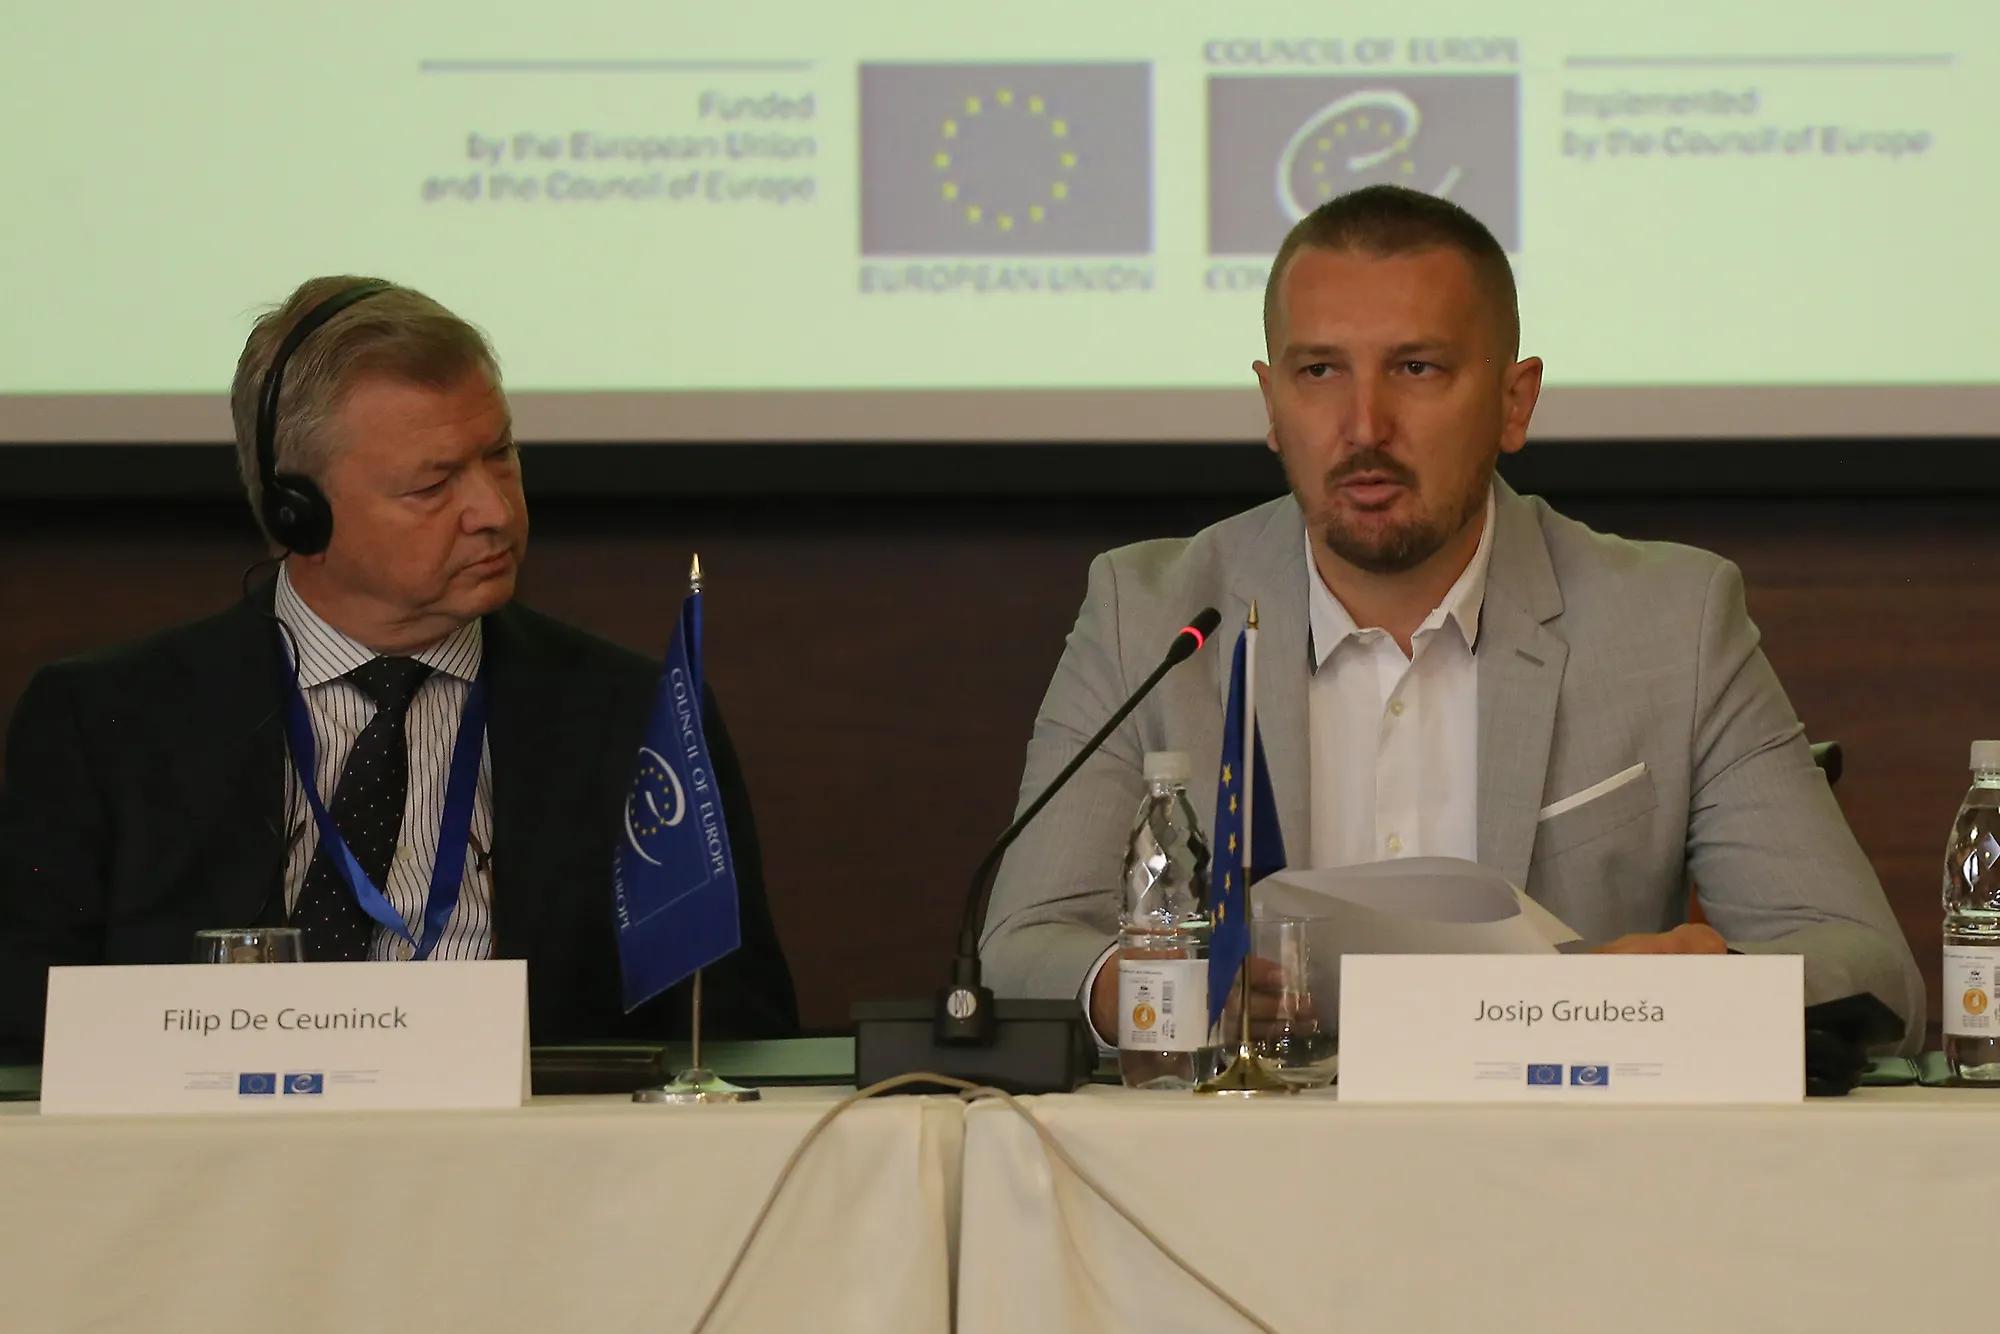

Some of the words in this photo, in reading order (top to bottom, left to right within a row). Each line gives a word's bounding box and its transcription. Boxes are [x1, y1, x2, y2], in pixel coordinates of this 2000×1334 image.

[1204, 38, 1345, 64] COUNCIL
[1354, 38, 1396, 64] OF
[1408, 38, 1521, 64] EUROPE
[698, 91, 816, 121] Funded
[1563, 88, 1761, 123] Implemented
[467, 132, 505, 166] by
[513, 132, 563, 160] the
[570, 132, 720, 165] European
[725, 132, 816, 160] Union
[1563, 127, 1600, 163] by
[1605, 126, 1656, 155] the
[1661, 126, 1779, 156] Council
[1783, 125, 1815, 155] of
[1820, 126, 1931, 160] Europe
[422, 172, 482, 203] and
[488, 172, 539, 201] the
[545, 170, 663, 202] Council
[668, 170, 699, 201] of
[704, 172, 816, 207] Europe
[859, 264, 1043, 293] EUROPEAN
[1049, 264, 1154, 293] UNION
[671, 667, 699, 758] COUNCIL
[691, 767, 709, 792] OF
[700, 801, 725, 877] EUROPE
[163, 1009, 221, 1036] Filip
[231, 1008, 268, 1031] De
[277, 1006, 408, 1030] Ceuninck
[1474, 1000, 1543, 1026] Josip
[1552, 1000, 1665, 1022] Grubeša
